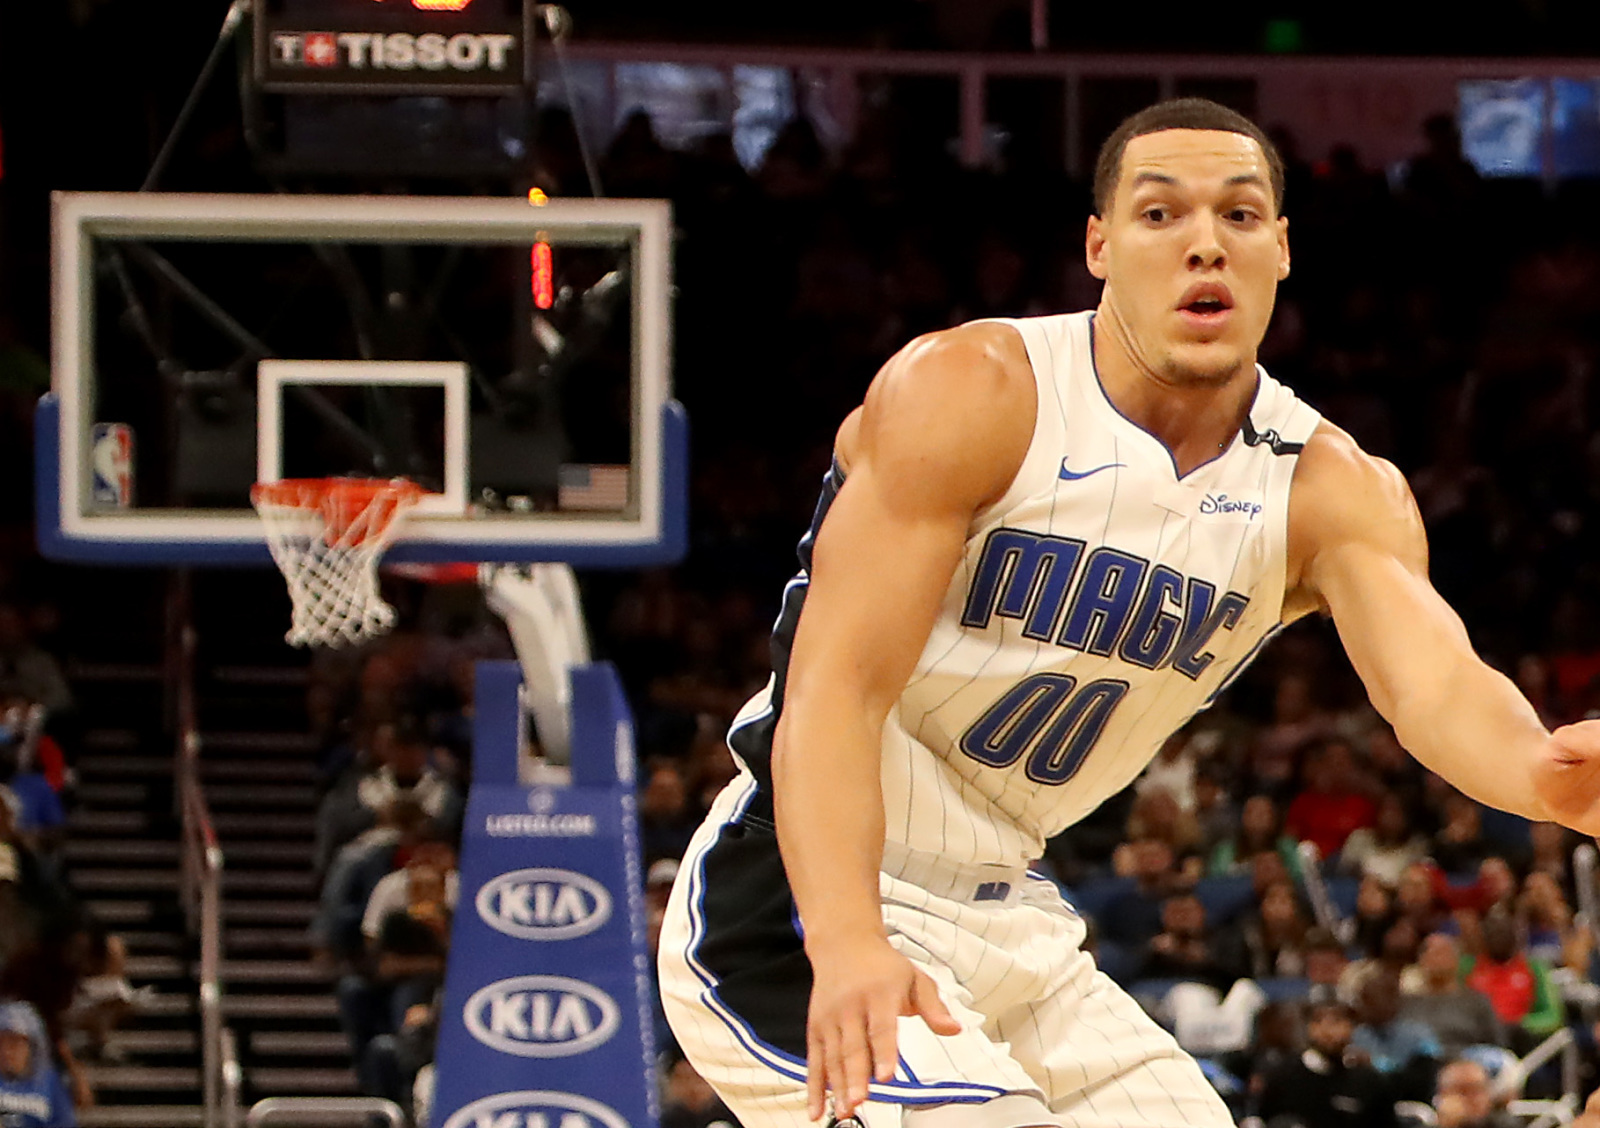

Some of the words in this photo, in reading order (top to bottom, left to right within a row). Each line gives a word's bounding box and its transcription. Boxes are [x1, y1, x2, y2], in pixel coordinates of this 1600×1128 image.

[337, 32, 515, 71] TISSOT
[960, 526, 1251, 682] MAGIC
[959, 671, 1131, 787] 00
[499, 883, 589, 925] KIA
[490, 992, 594, 1040] KIA
